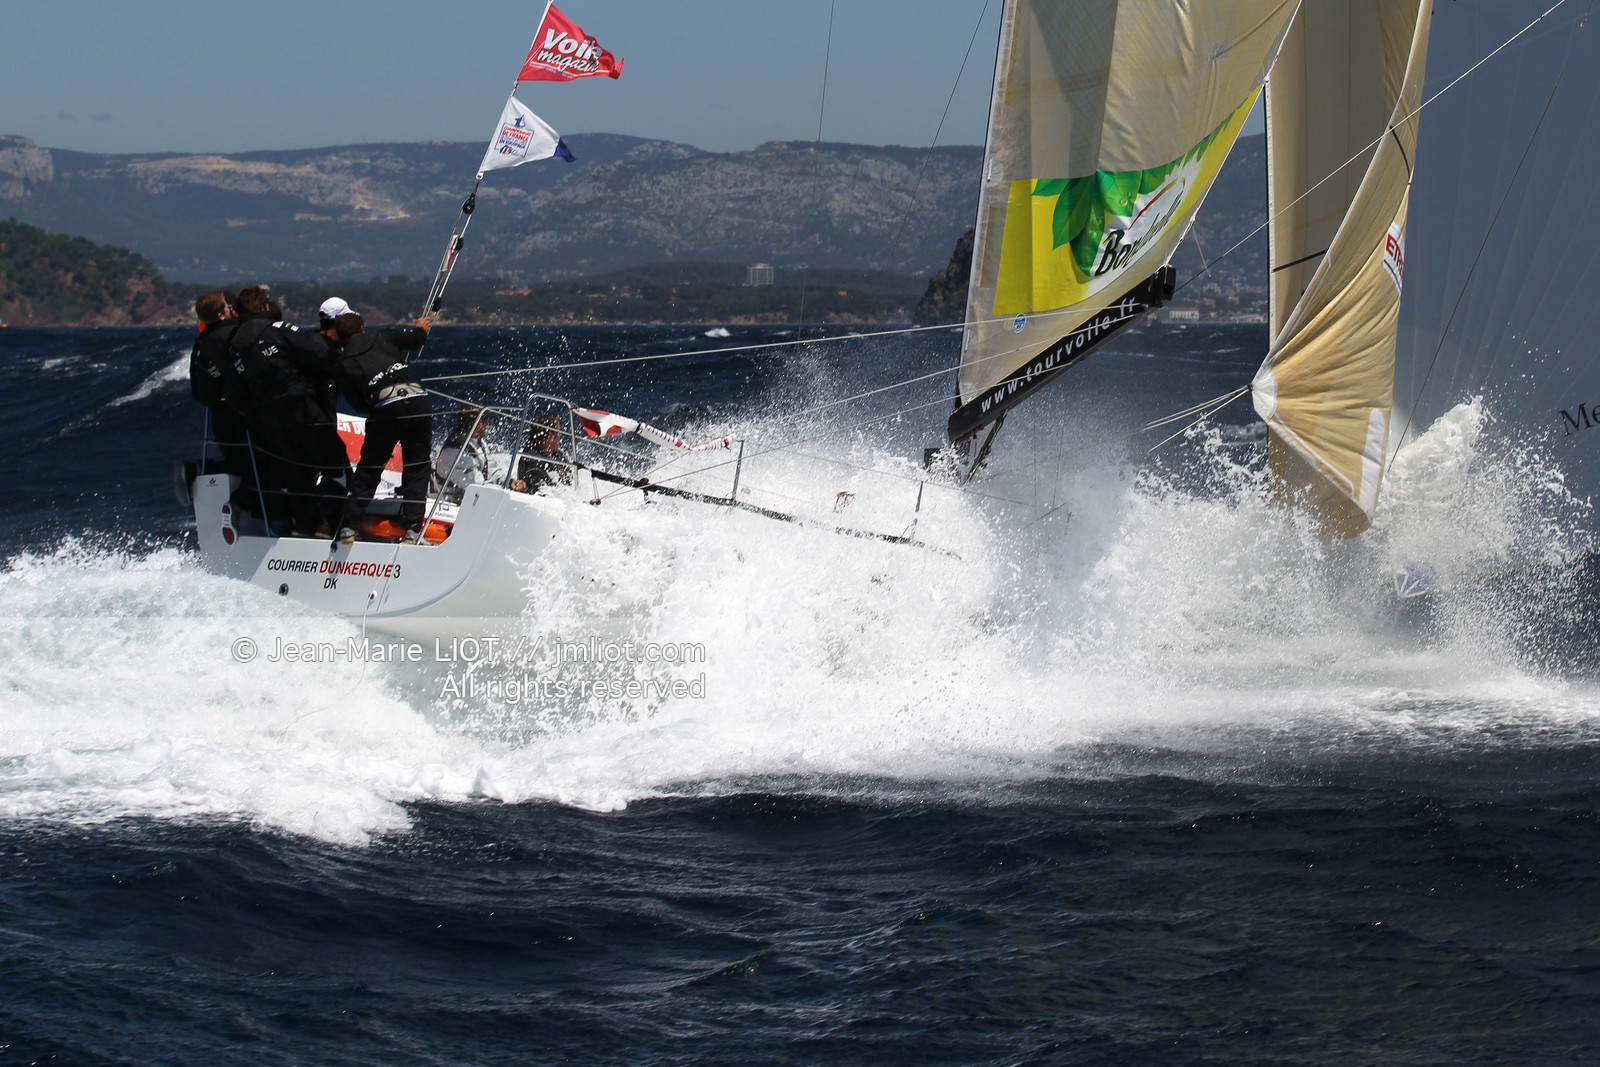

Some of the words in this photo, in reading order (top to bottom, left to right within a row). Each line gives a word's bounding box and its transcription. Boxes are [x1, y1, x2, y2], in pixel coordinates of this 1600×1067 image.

[981, 296, 1136, 413] www.tourvoile.fr
[267, 558, 319, 573] COURRIER
[319, 560, 393, 578] DUNKERQUE
[393, 564, 401, 579] 3
[323, 577, 338, 590] DK
